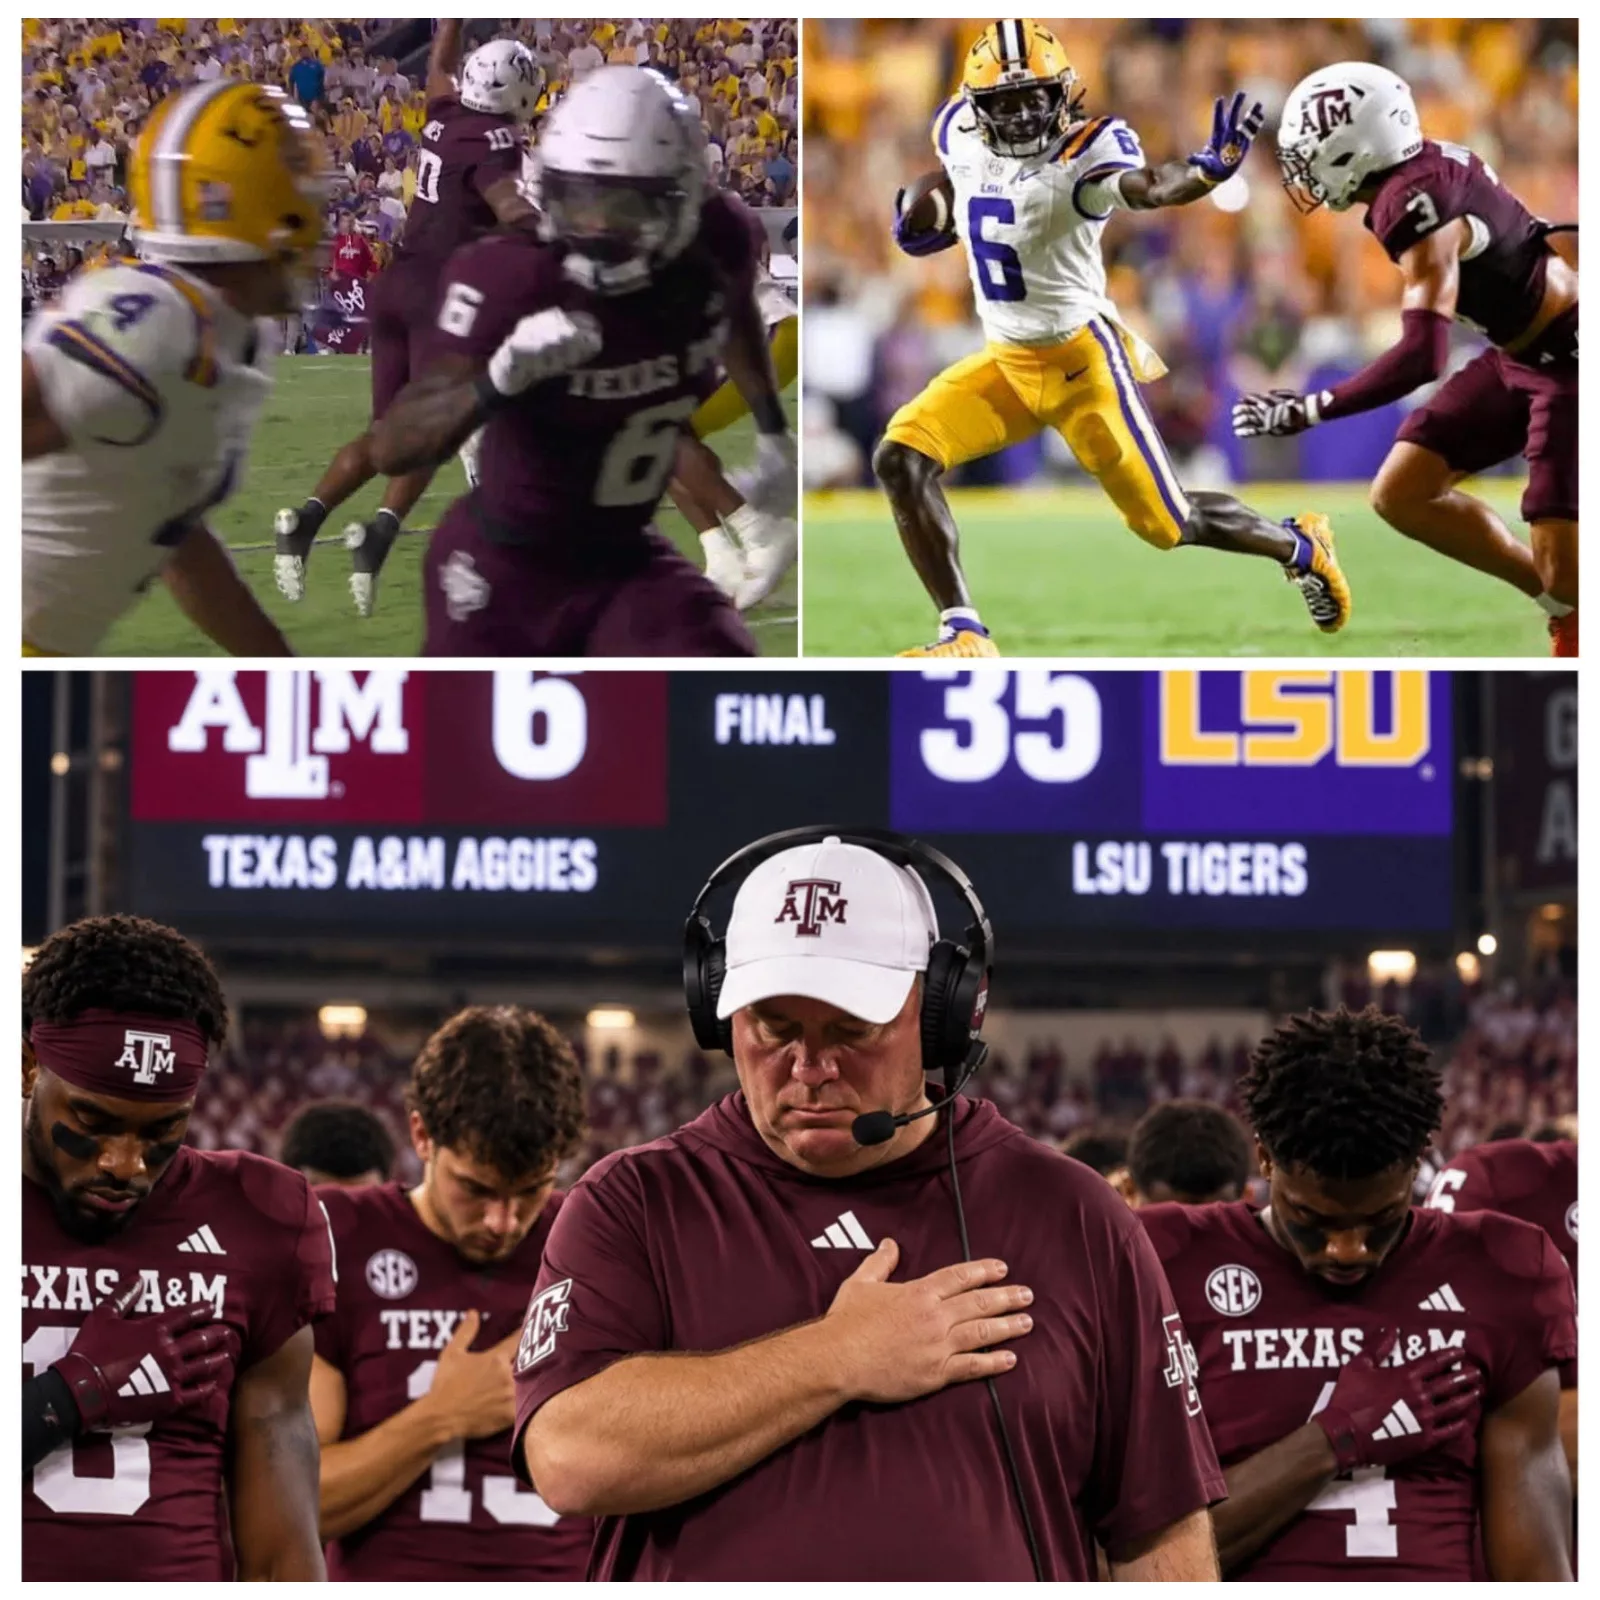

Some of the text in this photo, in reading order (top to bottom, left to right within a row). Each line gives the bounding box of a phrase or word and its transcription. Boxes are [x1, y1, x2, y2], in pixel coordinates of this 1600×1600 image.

[484, 127, 515, 151] 10
[1112, 128, 1140, 157] 6
[1406, 192, 1439, 233] 3
[968, 195, 1028, 302] 6
[438, 282, 486, 337] 6
[594, 396, 699, 507] 6
[491, 671, 588, 781] 6
[715, 692, 837, 745] FINAL
[919, 671, 1103, 783] 35
[1159, 671, 1431, 767] LSU
[202, 834, 599, 892] TEXAS A&M AGGIES
[1072, 840, 1309, 896] LSU TIGERS
[368, 1251, 416, 1297] SEC
[1208, 1267, 1258, 1314] SEC
[1223, 1328, 1364, 1371] TEXAS
